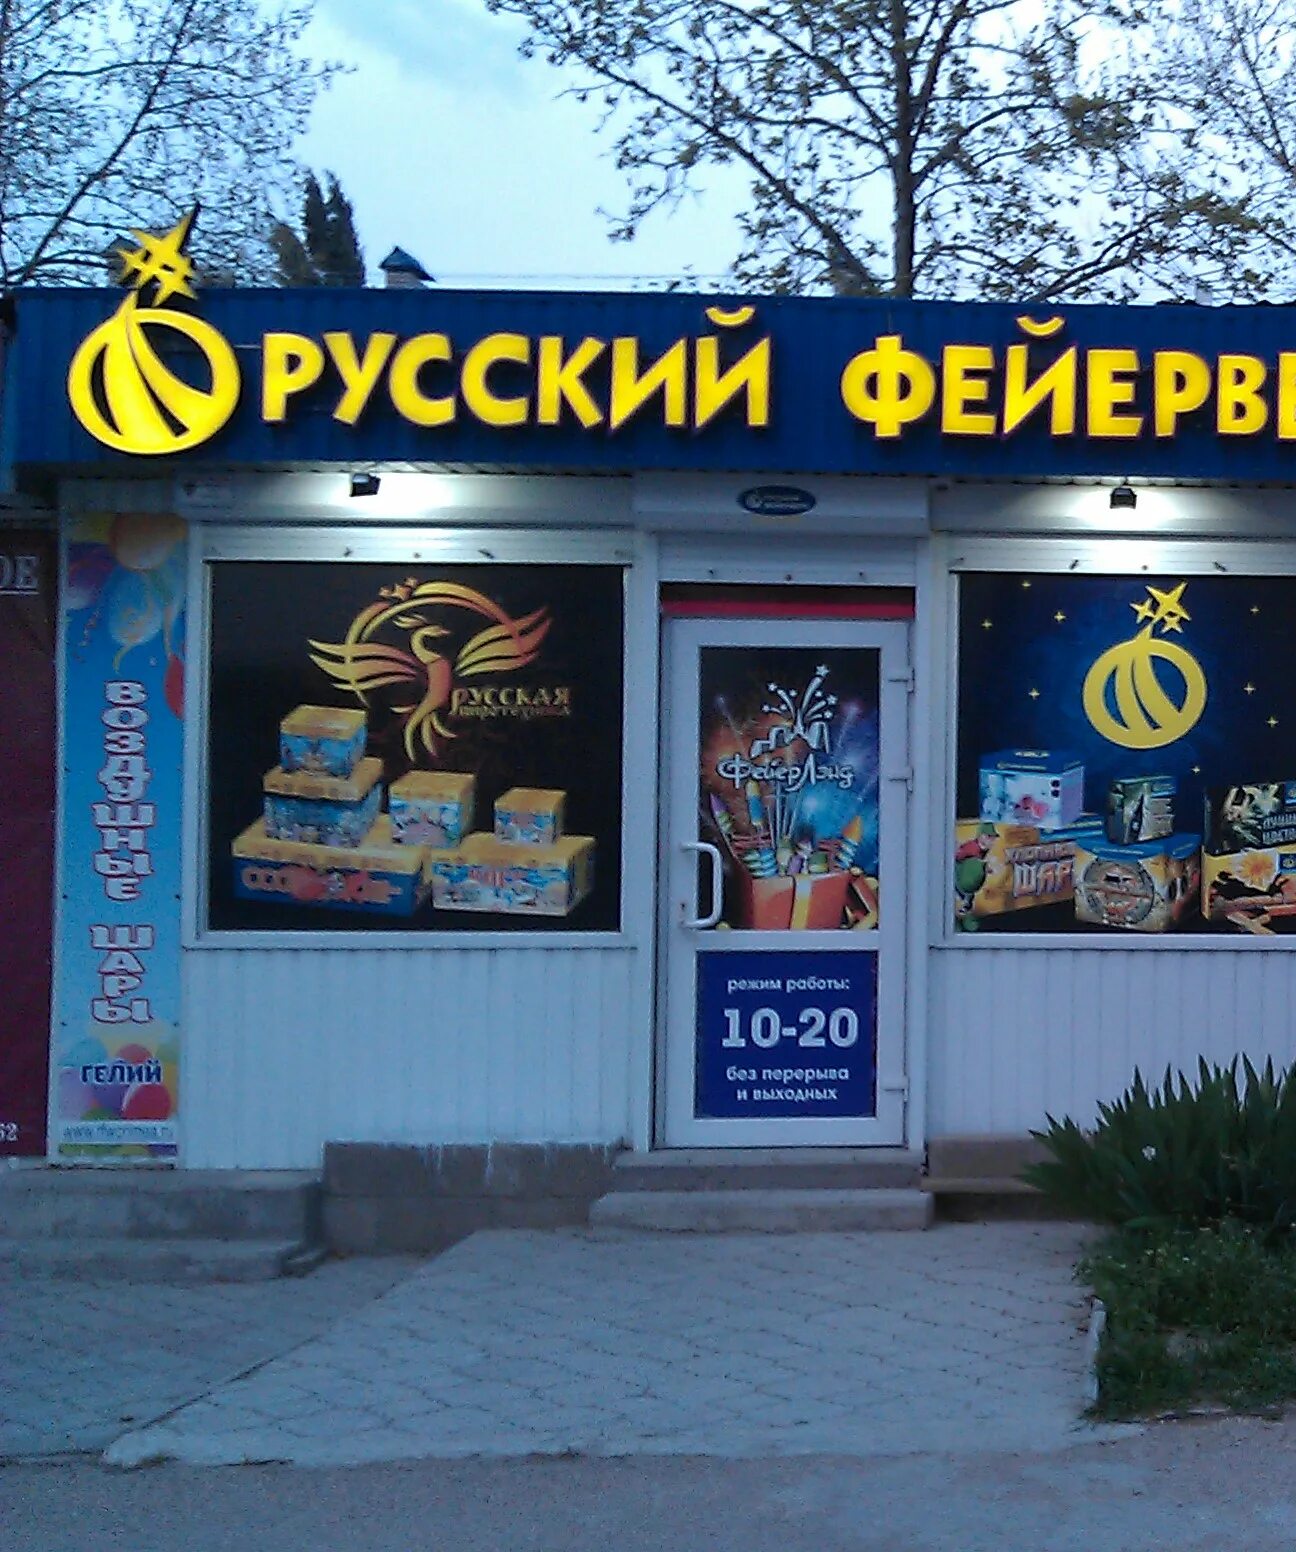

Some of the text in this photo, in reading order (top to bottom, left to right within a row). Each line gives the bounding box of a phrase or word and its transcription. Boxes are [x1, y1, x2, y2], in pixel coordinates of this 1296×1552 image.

[261, 306, 771, 430] РУССКИЙ
[92, 680, 155, 900] ВОЗДУШНЫЕ
[89, 924, 154, 1024] ШАРЫ
[727, 976, 850, 993] режим работы:
[721, 1007, 859, 1048] 10-20
[81, 1059, 162, 1083] ГЕЛИЙ
[726, 1065, 850, 1084] без перерыва
[736, 1088, 838, 1102] и выходных
